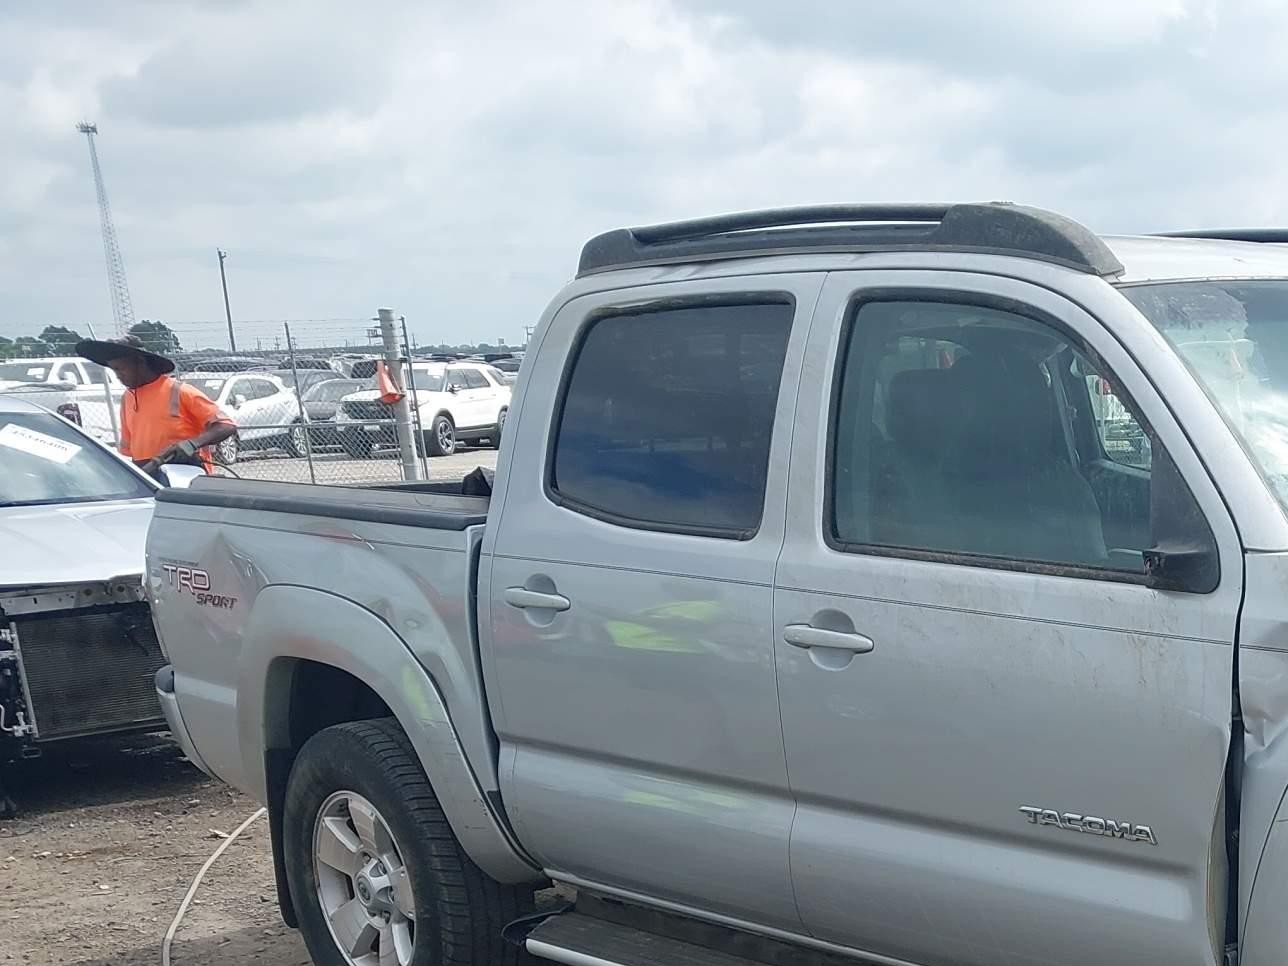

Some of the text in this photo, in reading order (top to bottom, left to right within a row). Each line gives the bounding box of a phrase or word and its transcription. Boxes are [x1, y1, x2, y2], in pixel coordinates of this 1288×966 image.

[162, 563, 211, 593] TRD
[196, 593, 237, 610] SPORT
[1018, 805, 1158, 846] TACOMA
